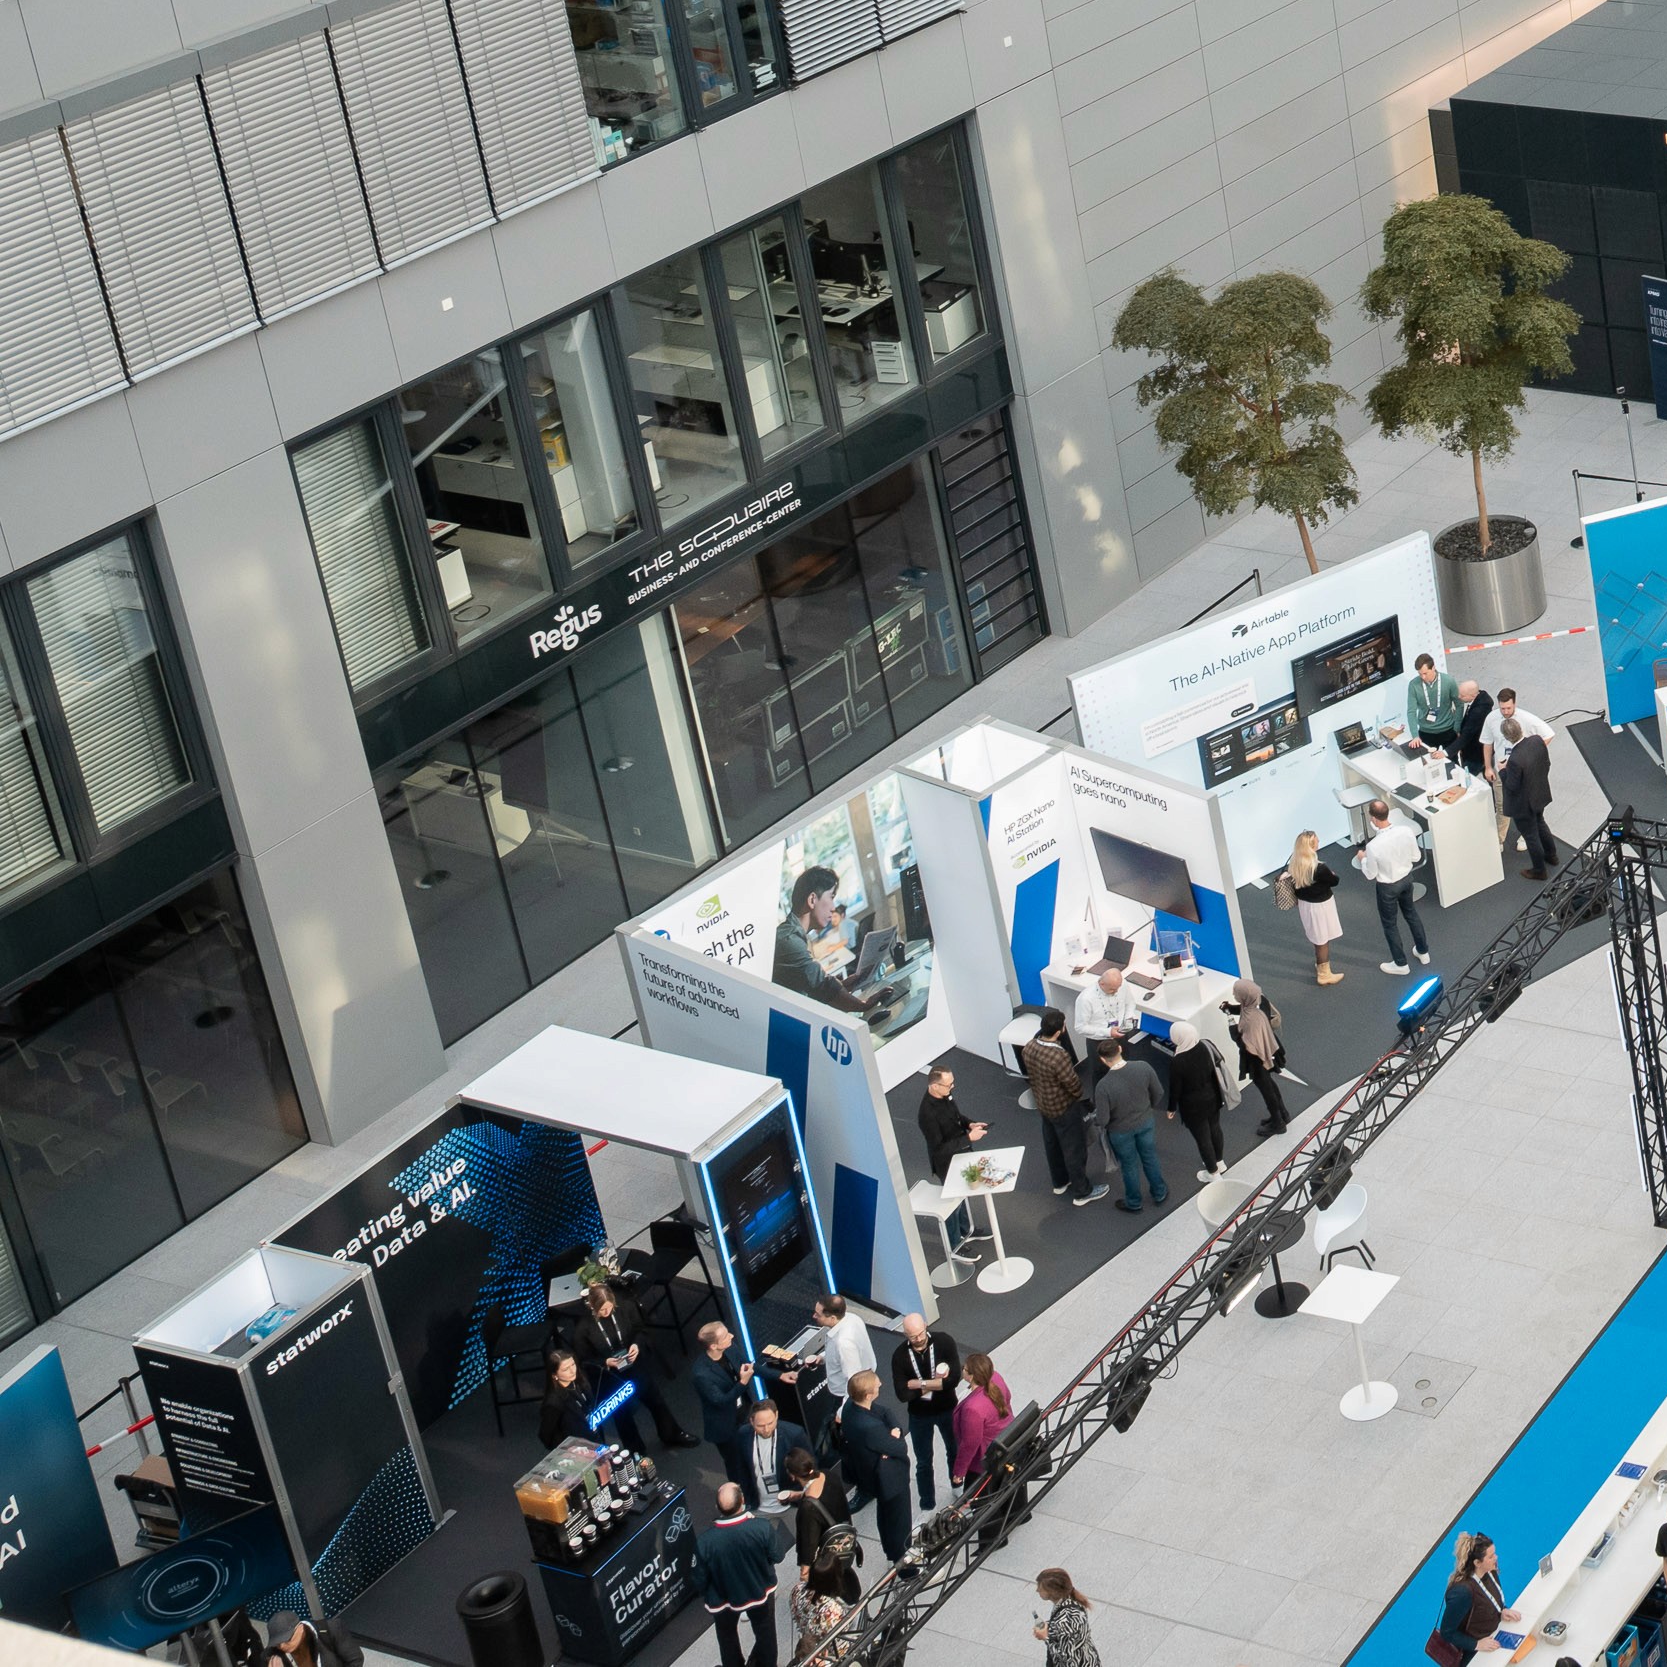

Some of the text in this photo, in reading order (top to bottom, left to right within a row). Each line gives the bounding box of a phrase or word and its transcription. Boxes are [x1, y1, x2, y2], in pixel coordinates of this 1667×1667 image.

[1649, 305, 1667, 320] Turning
[1650, 316, 1661, 327] into
[1651, 325, 1662, 336] into
[627, 498, 802, 605] BUSINESS- AND CONFERENCE-CENTER
[628, 550, 674, 583] THE
[529, 604, 602, 658] Regus
[1250, 608, 1290, 631] Airtable
[1169, 605, 1357, 692] The AI-Native App Platform
[1070, 766, 1168, 812] AI Supercomputing
[1073, 782, 1127, 809] goes nano
[1004, 799, 1056, 835] HP ZGX Nano
[1007, 818, 1044, 845] AI Station
[1026, 838, 1057, 861] NVIDIA
[696, 910, 730, 934] NVIDIA
[726, 923, 755, 948] the
[738, 942, 755, 966] AI
[638, 952, 726, 999] Transforming the
[642, 968, 740, 1019] future of advanced
[647, 987, 699, 1017] workflows
[824, 1024, 850, 1065] hp
[332, 1157, 467, 1261] eating value
[372, 1179, 478, 1268] Data & AI.
[266, 1302, 353, 1376] statworx
[160, 1397, 170, 1406] We
[171, 1400, 193, 1411] enable
[165, 1413, 194, 1426] potential
[197, 1413, 207, 1421] the
[591, 1383, 634, 1430] AI DRINKS
[168, 1576, 200, 1594] alteryx
[609, 1554, 662, 1610] Flavor
[615, 1558, 679, 1624] Curator
